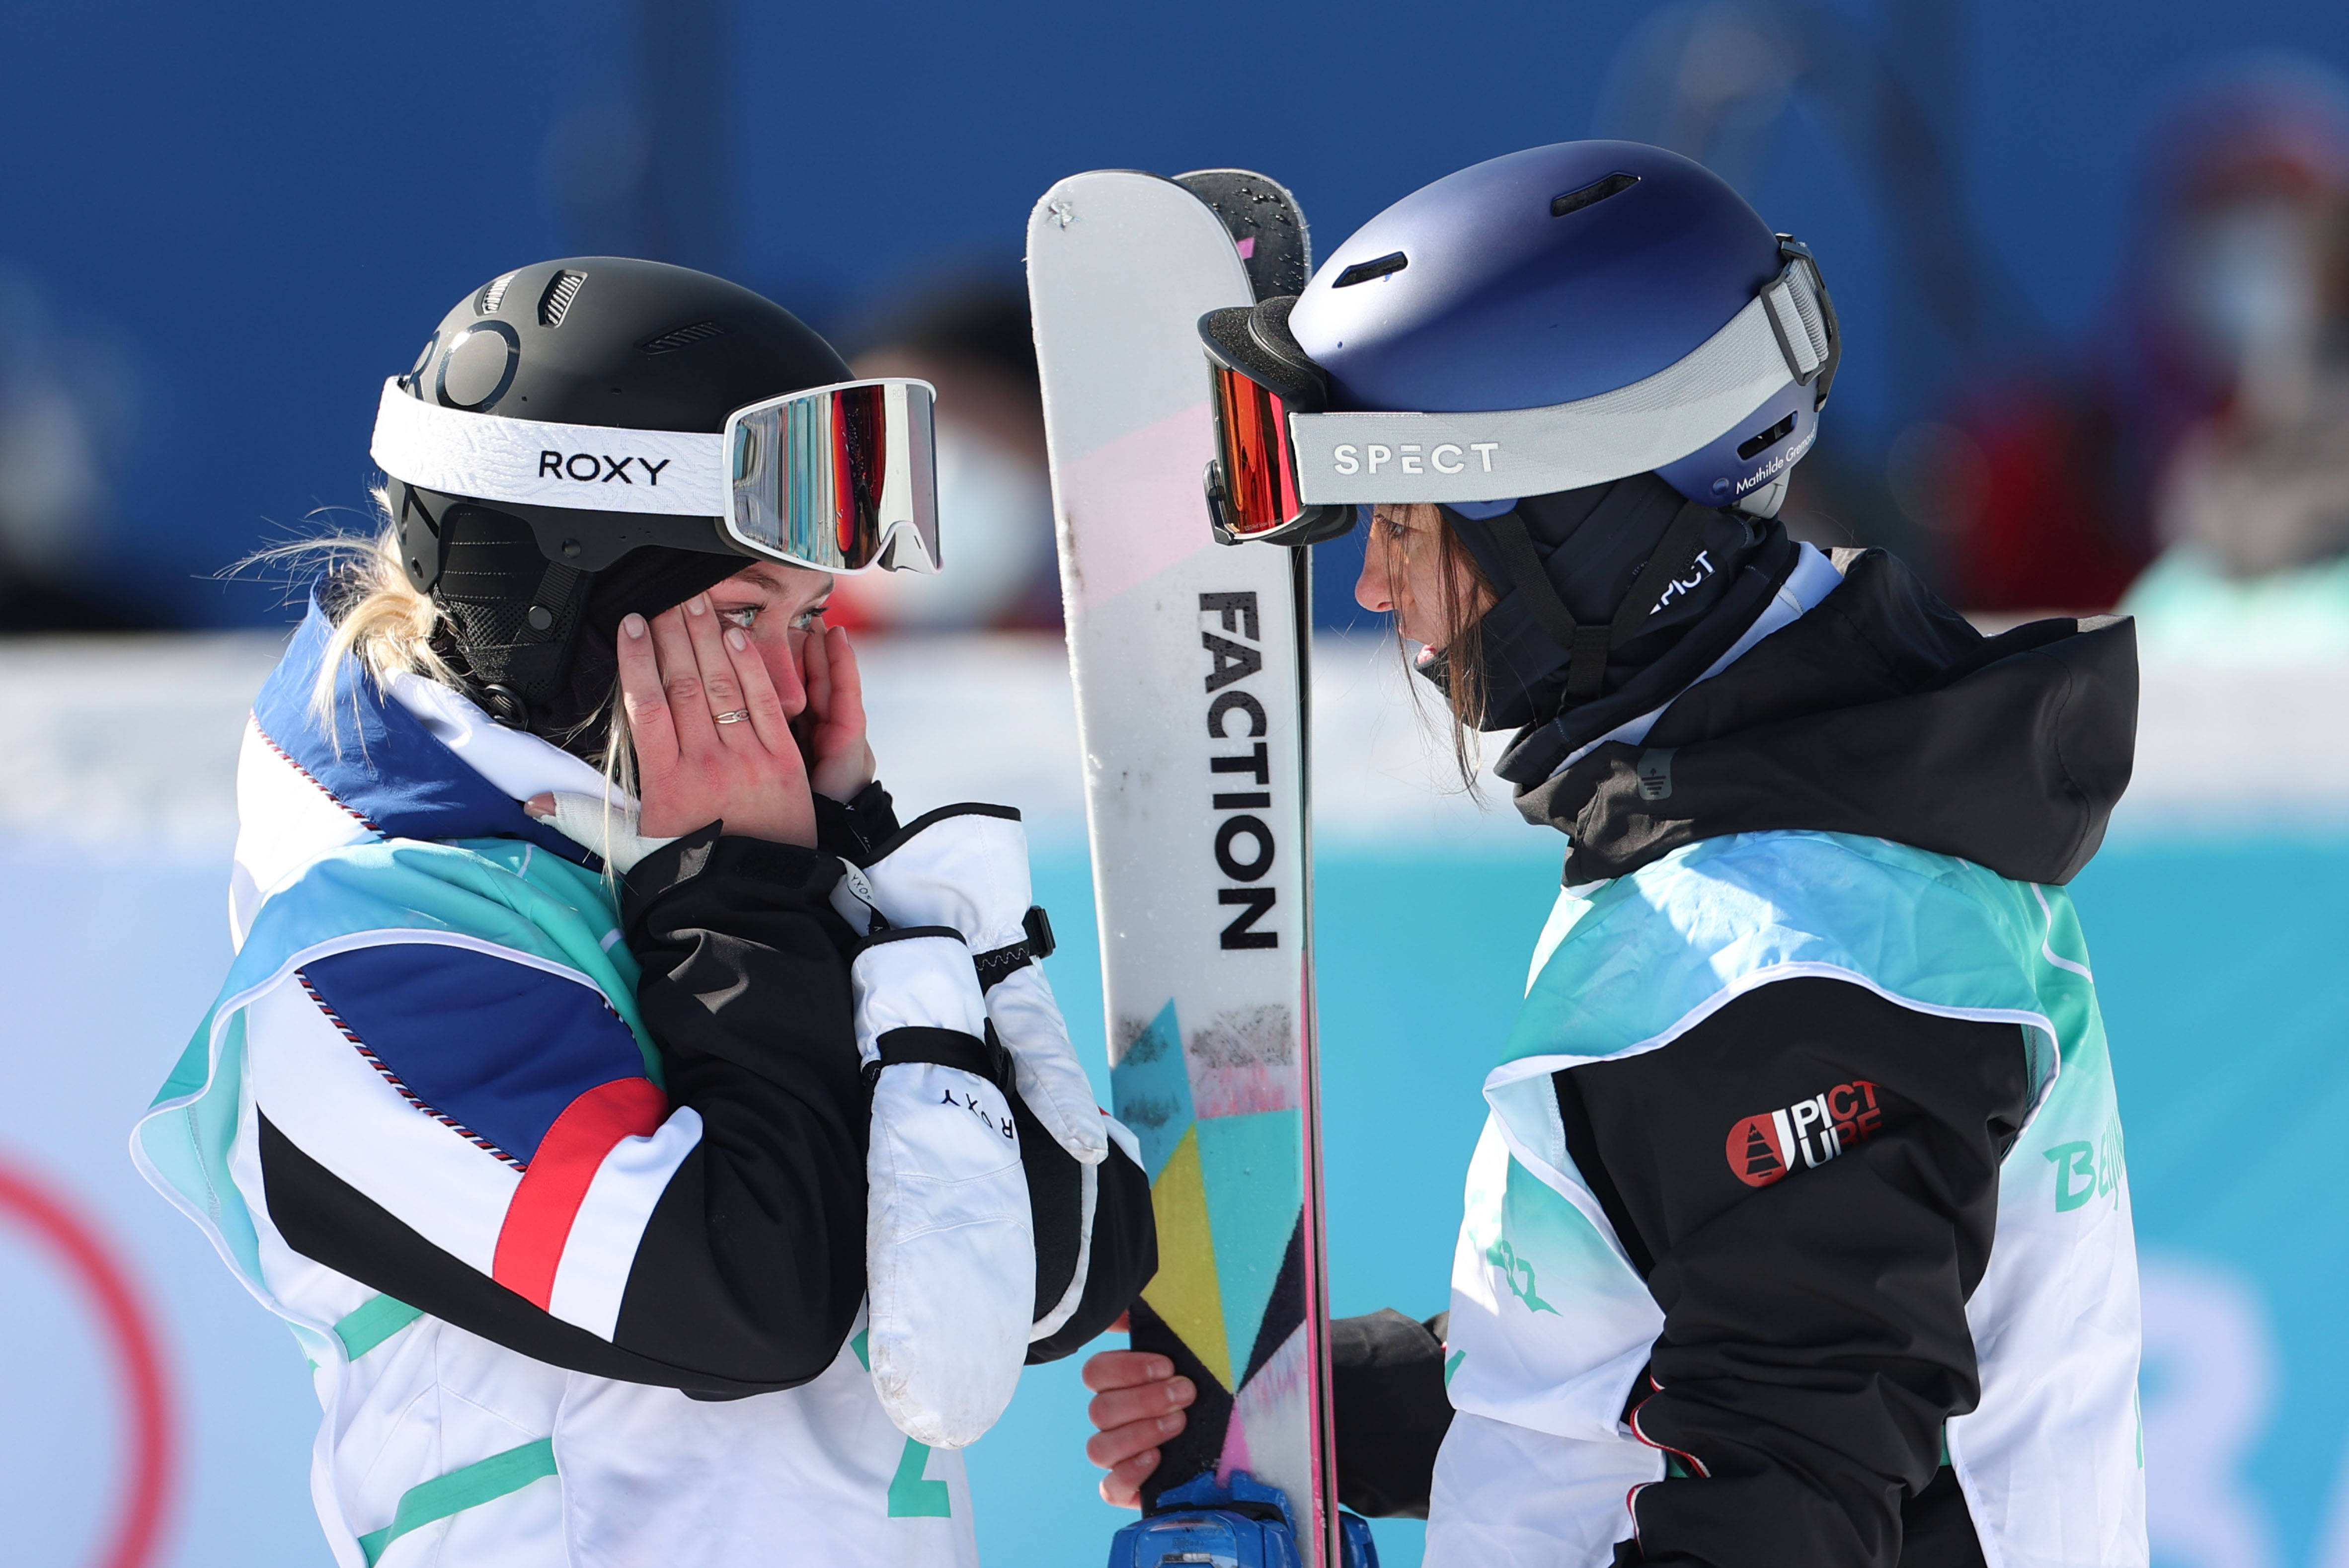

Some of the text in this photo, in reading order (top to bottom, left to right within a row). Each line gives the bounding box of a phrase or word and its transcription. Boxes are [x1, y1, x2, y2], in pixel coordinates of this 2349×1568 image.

[539, 450, 671, 486] ROXY
[1334, 443, 1498, 475] SPECT
[1736, 457, 1784, 495] Mathilde
[1198, 591, 1278, 950] FACTION
[940, 1089, 1014, 1139] ROXY
[1791, 1081, 1880, 1140] PICT
